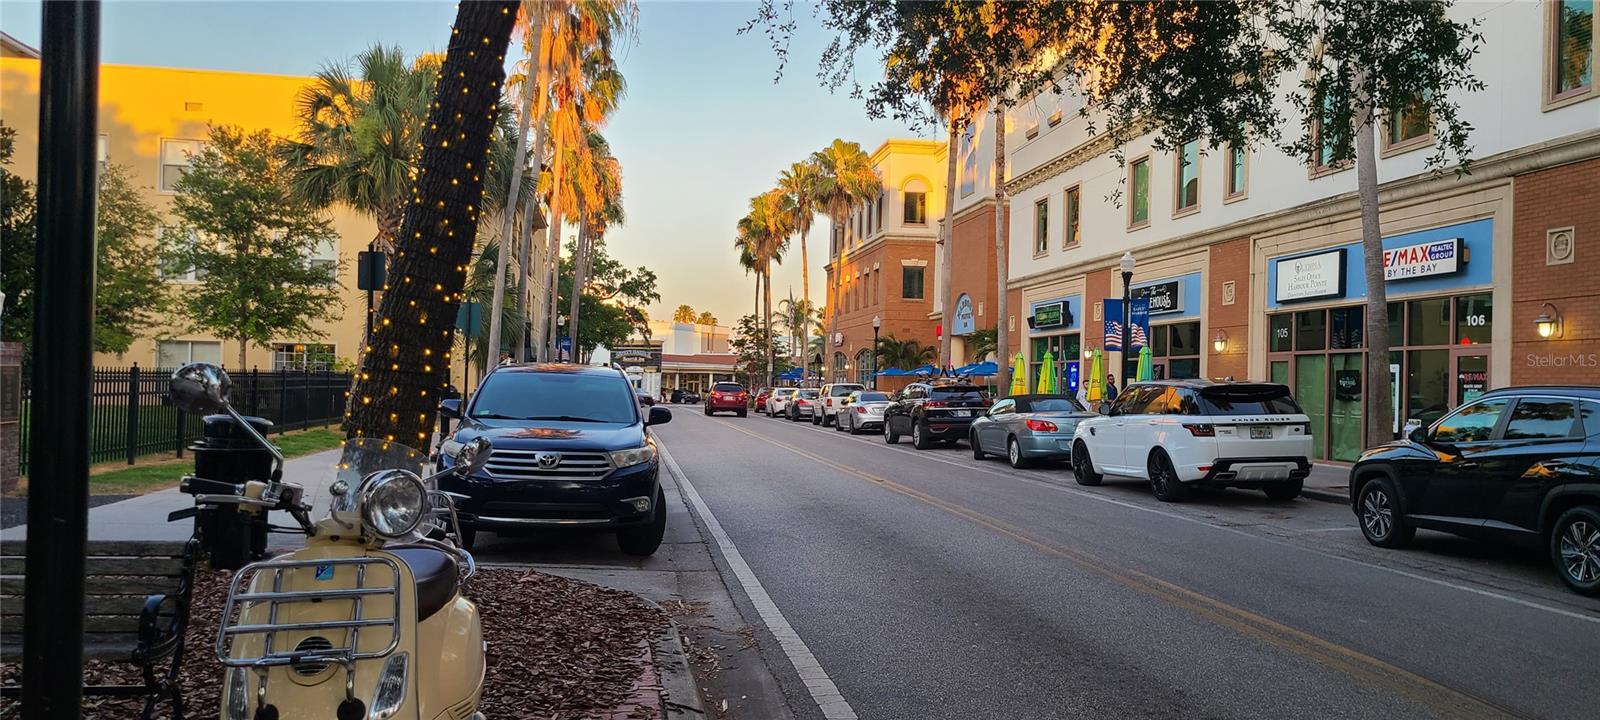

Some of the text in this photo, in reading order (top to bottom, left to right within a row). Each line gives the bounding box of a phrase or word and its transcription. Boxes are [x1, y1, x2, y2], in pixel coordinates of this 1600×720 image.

[1431, 243, 1453, 251] REALTEC
[1383, 245, 1429, 267] E/MAX
[1431, 251, 1453, 260] GROUP
[1387, 263, 1438, 278] BY THE BAY
[1466, 315, 1486, 326] 106
[1277, 328, 1289, 338] 105
